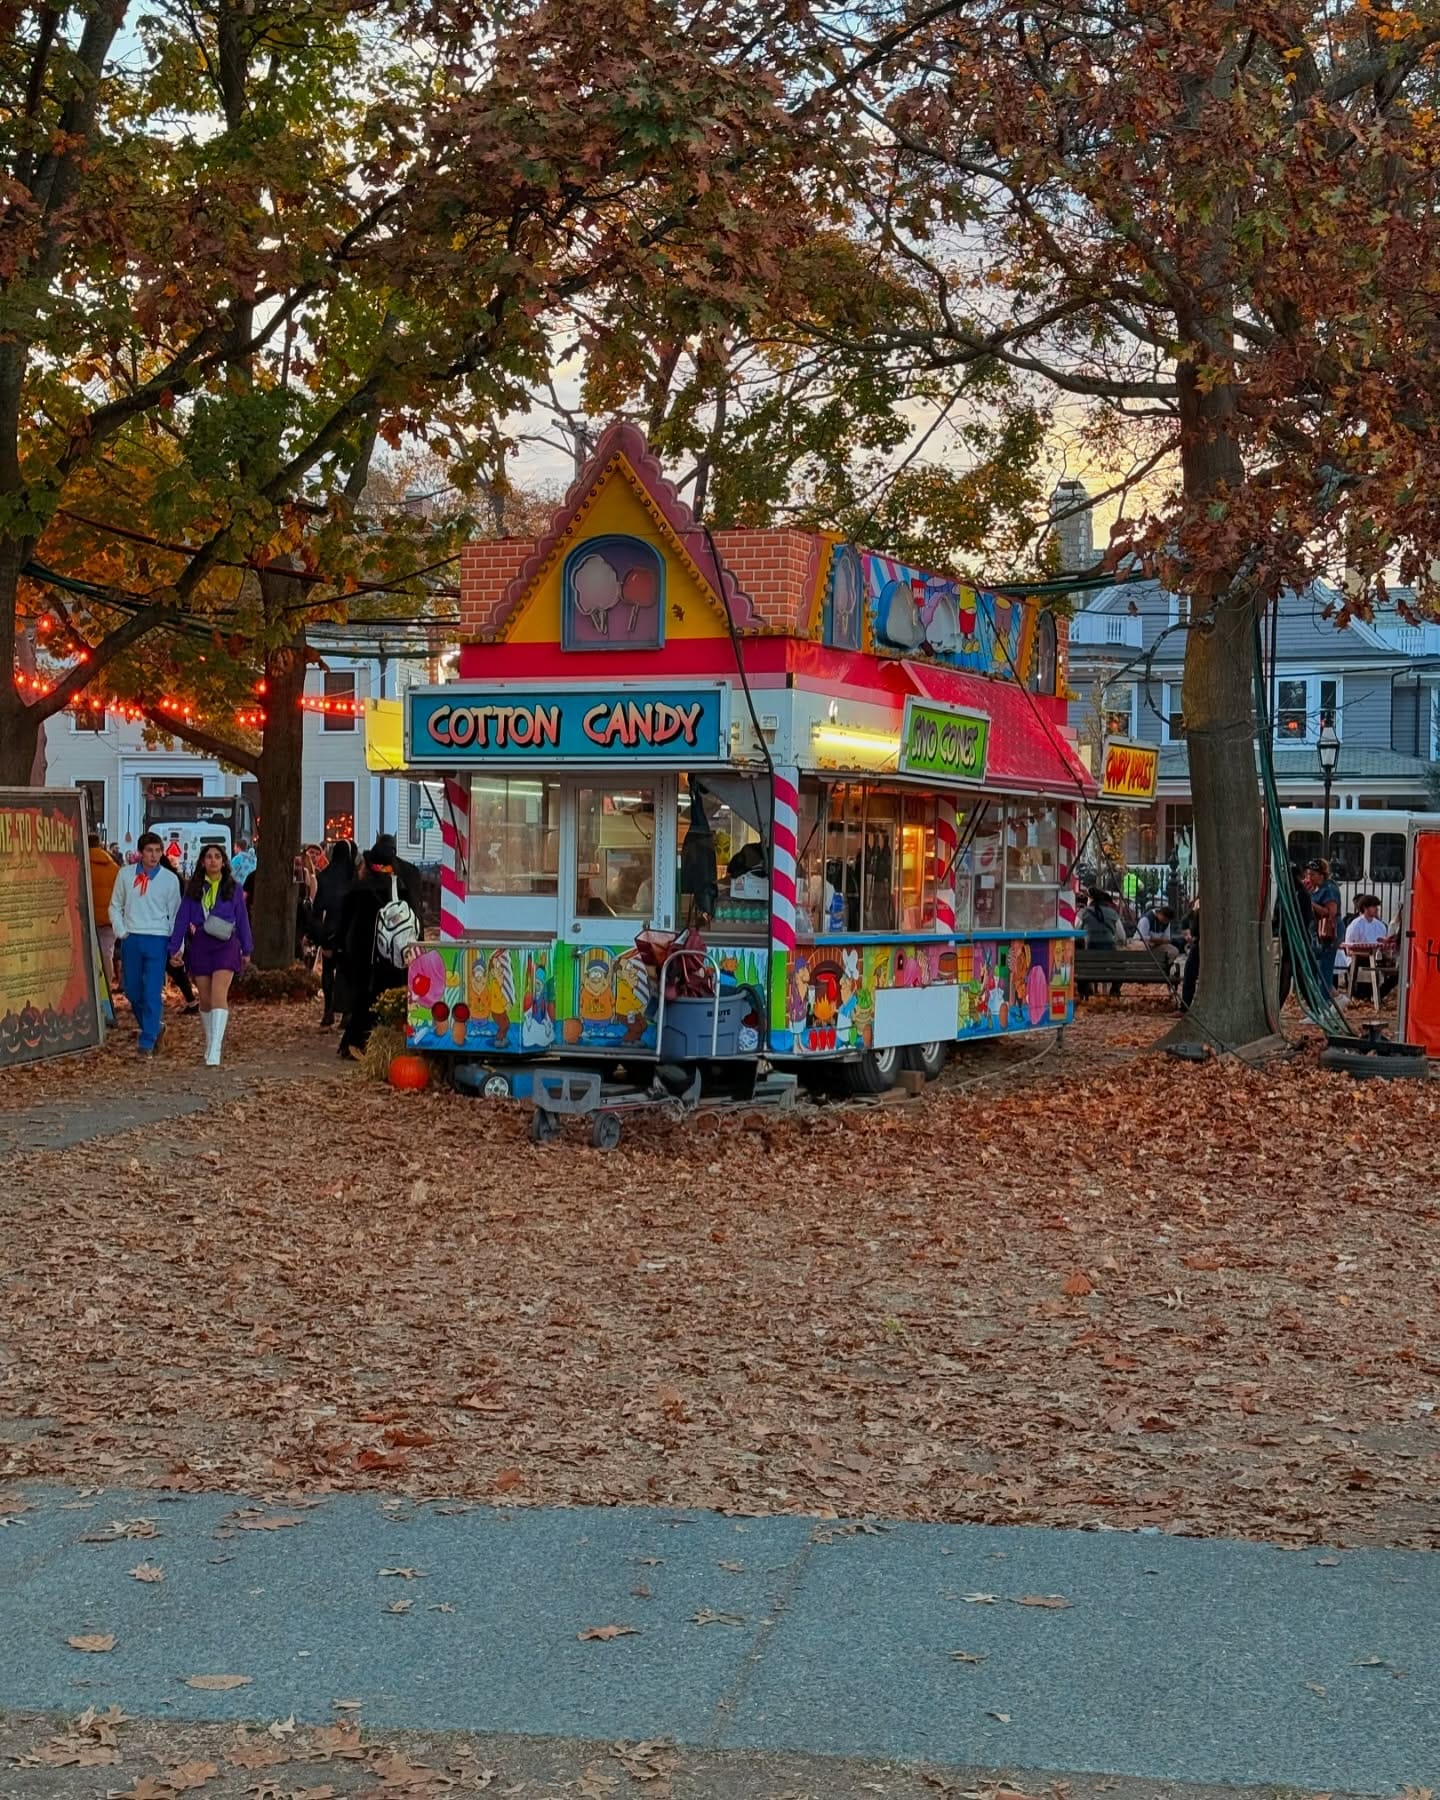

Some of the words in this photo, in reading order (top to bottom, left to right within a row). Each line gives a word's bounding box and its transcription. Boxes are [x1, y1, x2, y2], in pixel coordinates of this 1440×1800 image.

[427, 704, 562, 748] COTTON
[583, 700, 704, 747] CANDY
[911, 714, 938, 761] SNO
[941, 721, 978, 770] CONES
[15, 812, 32, 853] TO
[36, 813, 75, 854] SALEM
